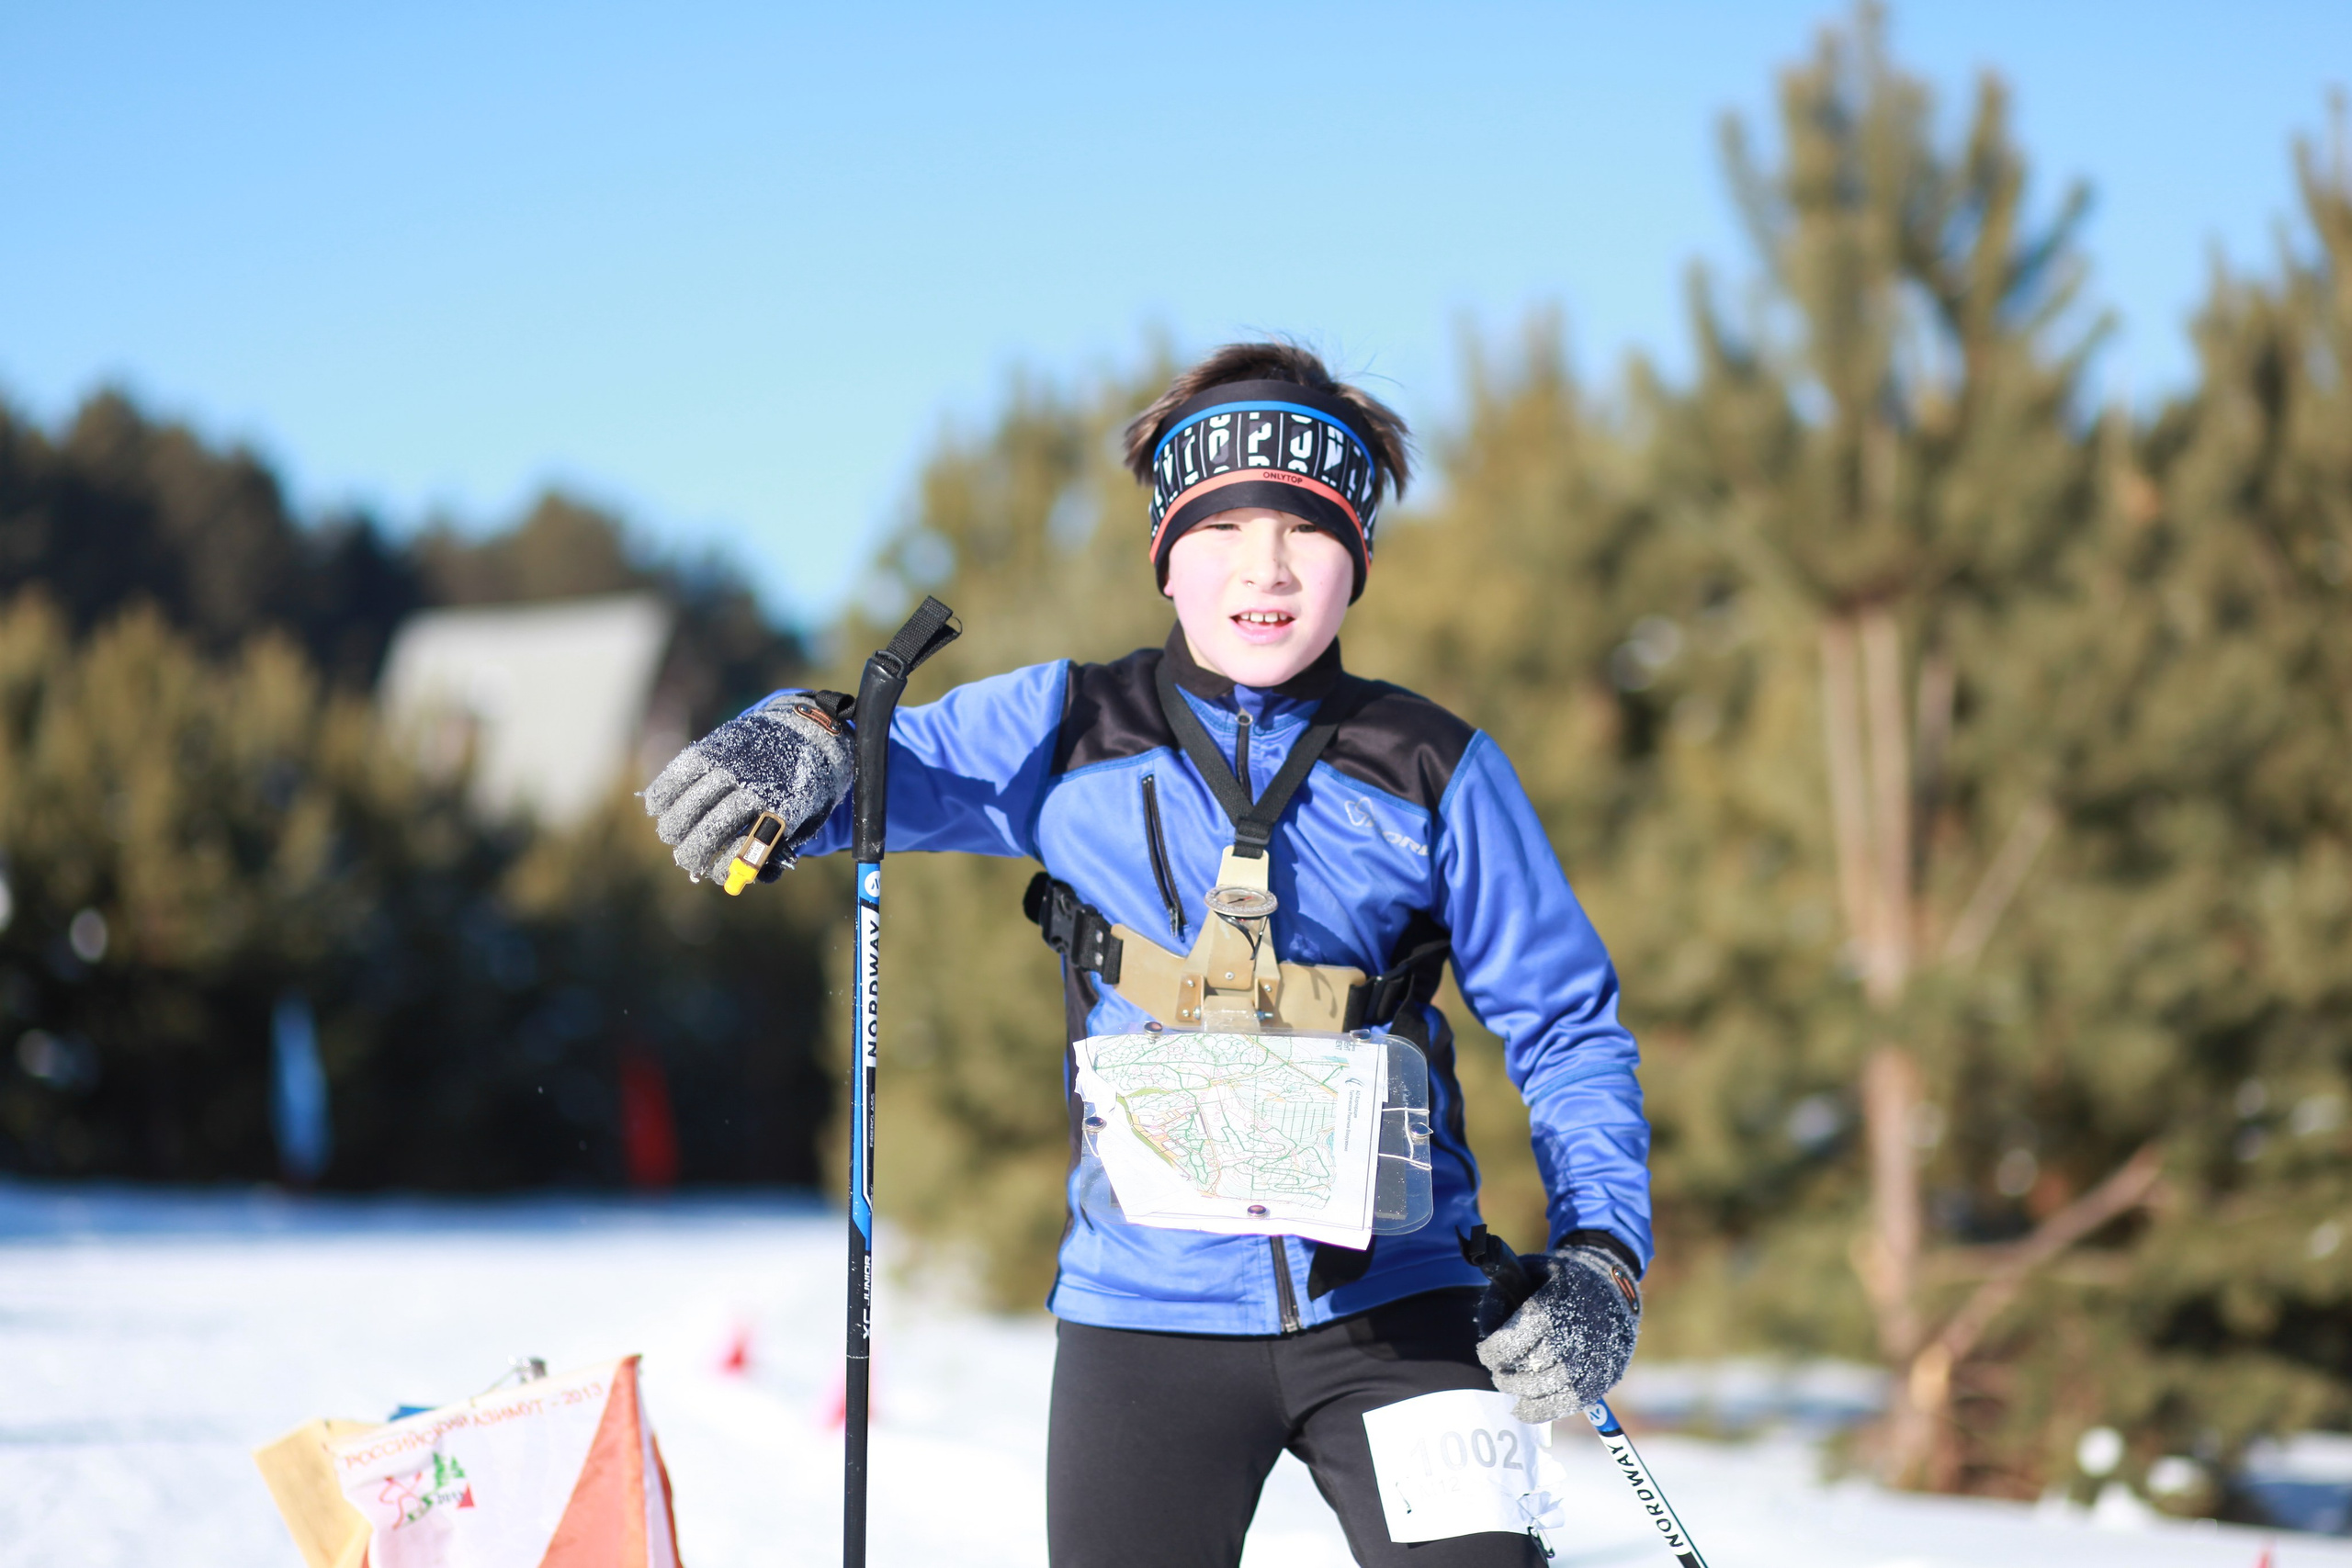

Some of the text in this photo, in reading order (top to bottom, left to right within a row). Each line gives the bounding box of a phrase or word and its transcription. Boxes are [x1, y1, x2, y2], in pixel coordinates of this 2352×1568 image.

[1262, 470, 1304, 485] ONLYTOP
[867, 919, 879, 1058] NORDWAY
[472, 1397, 545, 1428] АЗИМУТ
[561, 1381, 604, 1406] 2013
[1409, 1428, 1525, 1477] 1002
[1606, 1443, 1684, 1549] NORDWAY
